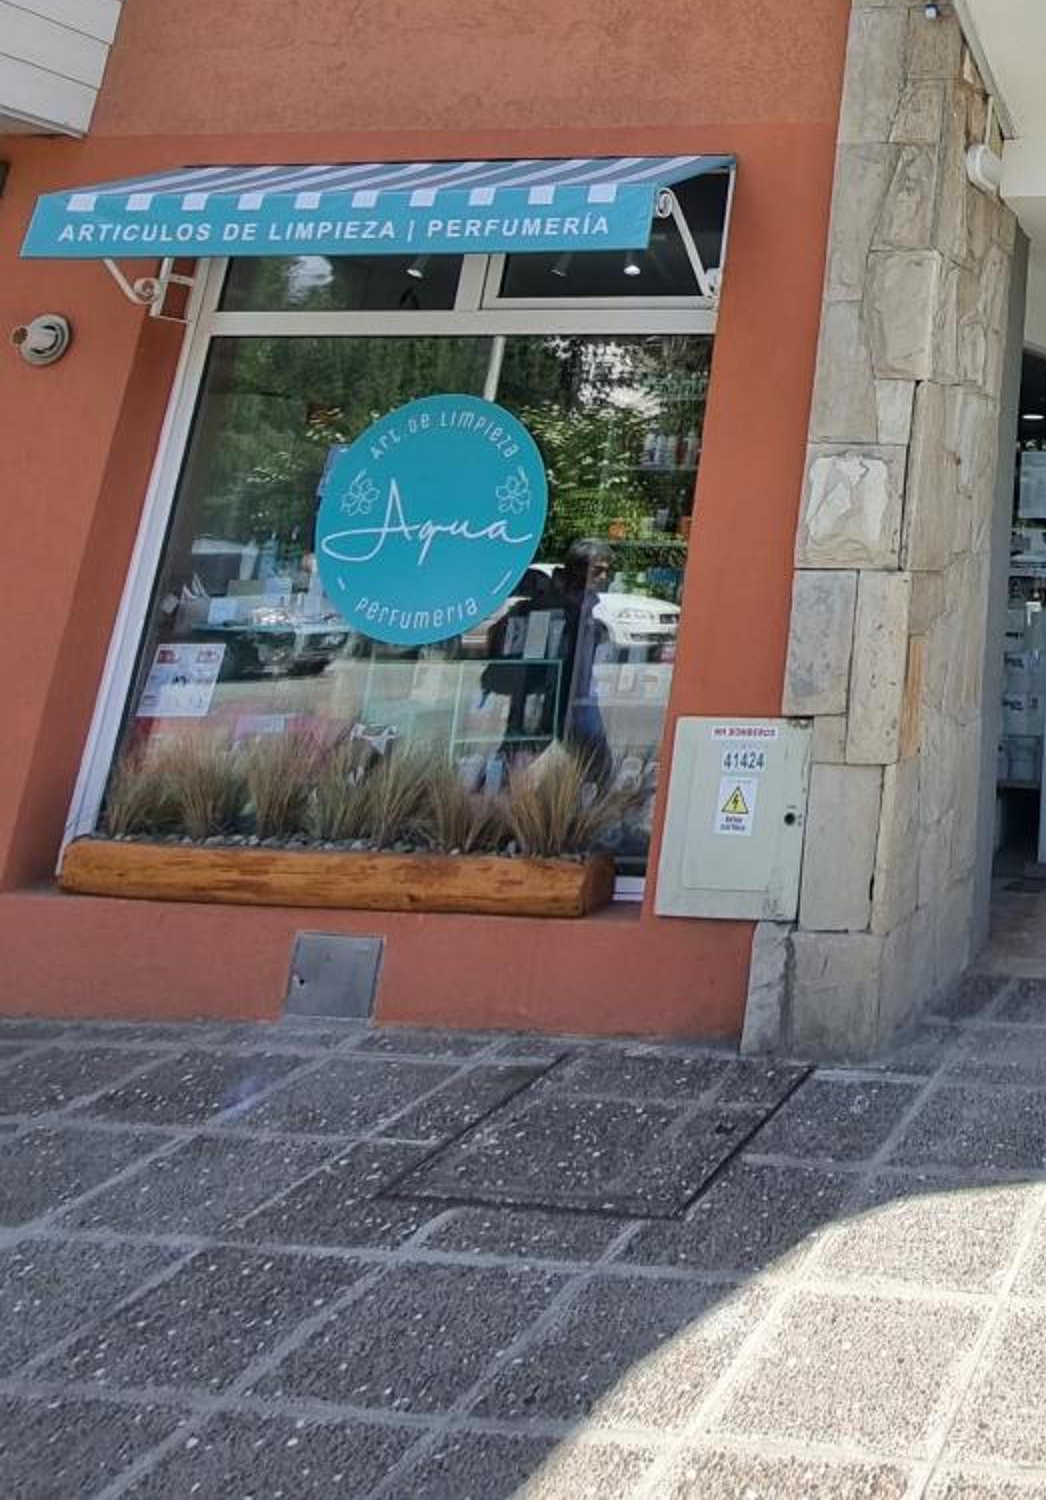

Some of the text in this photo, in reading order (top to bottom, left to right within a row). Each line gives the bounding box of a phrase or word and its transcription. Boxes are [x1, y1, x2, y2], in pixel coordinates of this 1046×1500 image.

[57, 222, 211, 243] ARTICULOS
[221, 222, 258, 242] DE
[267, 219, 396, 241] LIMPIEZA
[426, 211, 610, 239] PERFUMERÍA
[320, 477, 534, 566] Aqua
[723, 751, 765, 770] 41424
